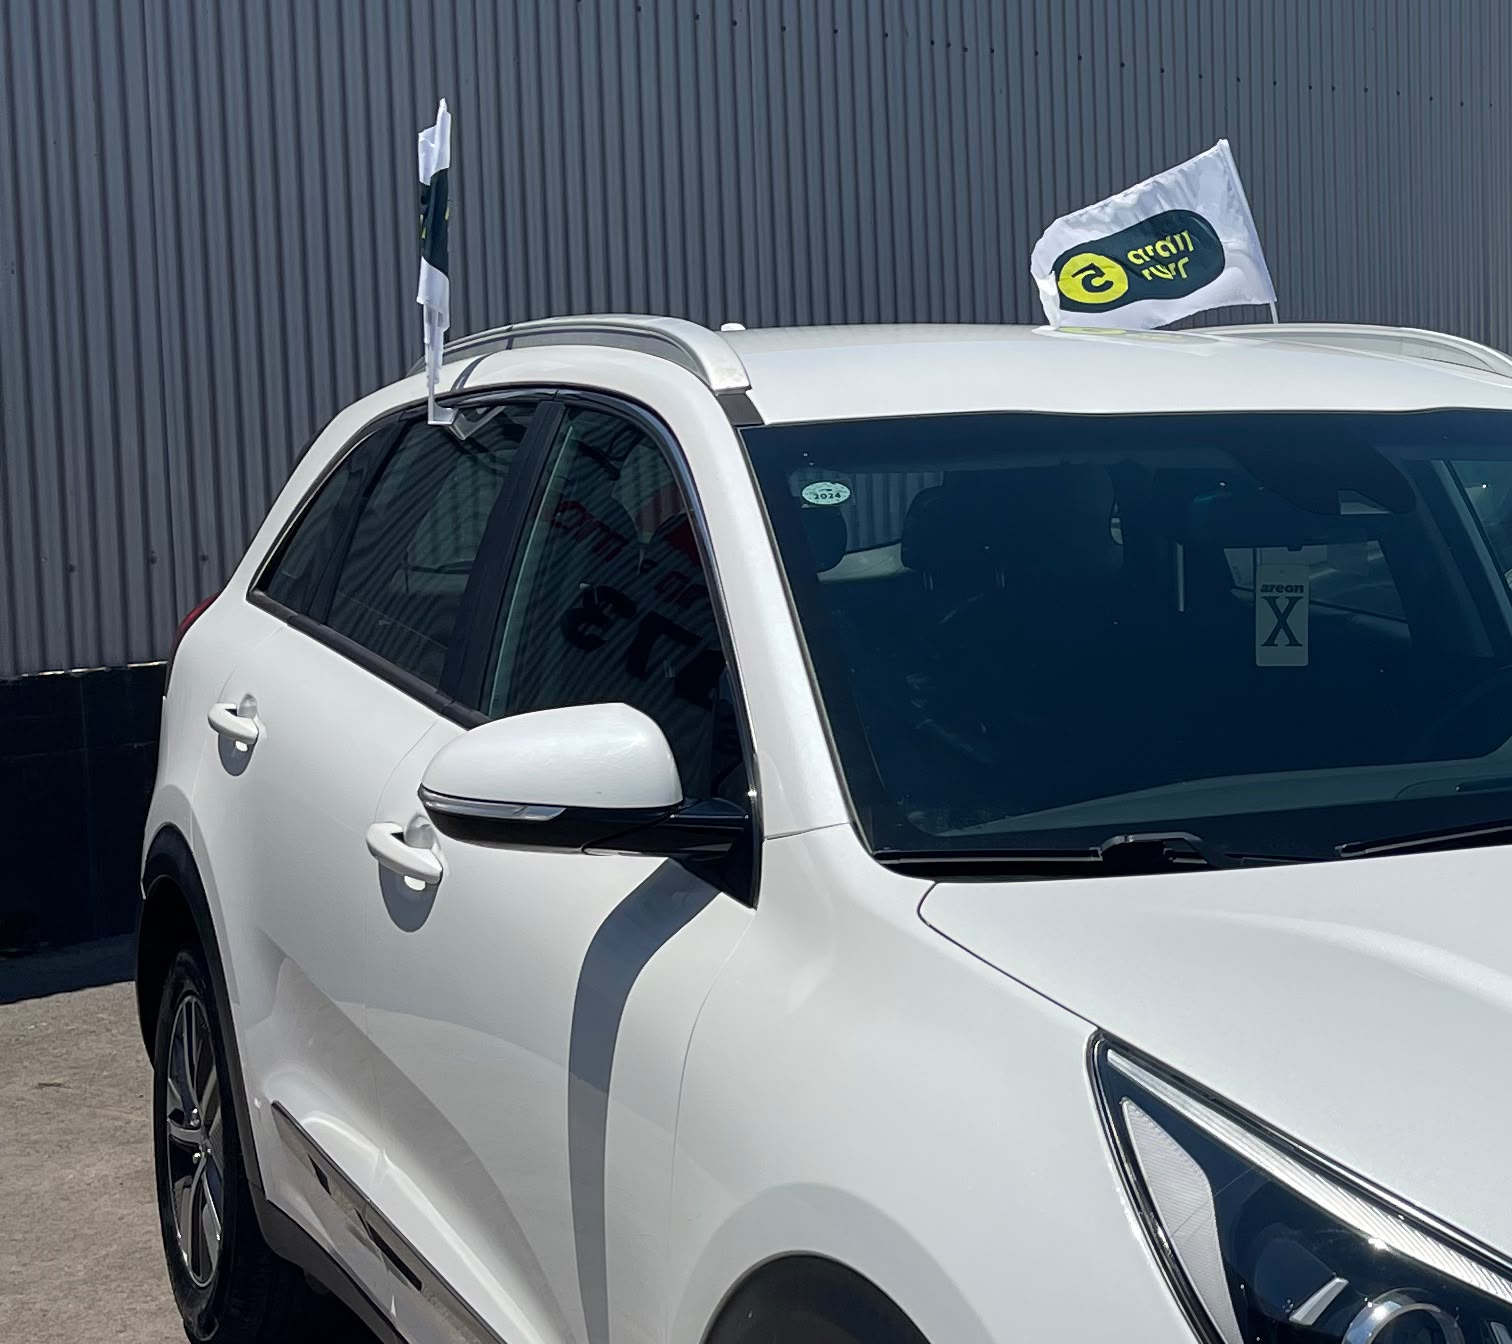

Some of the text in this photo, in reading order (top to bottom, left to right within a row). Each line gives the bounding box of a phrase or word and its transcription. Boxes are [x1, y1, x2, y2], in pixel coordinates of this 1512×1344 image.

[814, 492, 842, 500] 2024
[1260, 583, 1304, 593] areon
[1260, 596, 1303, 647] X
